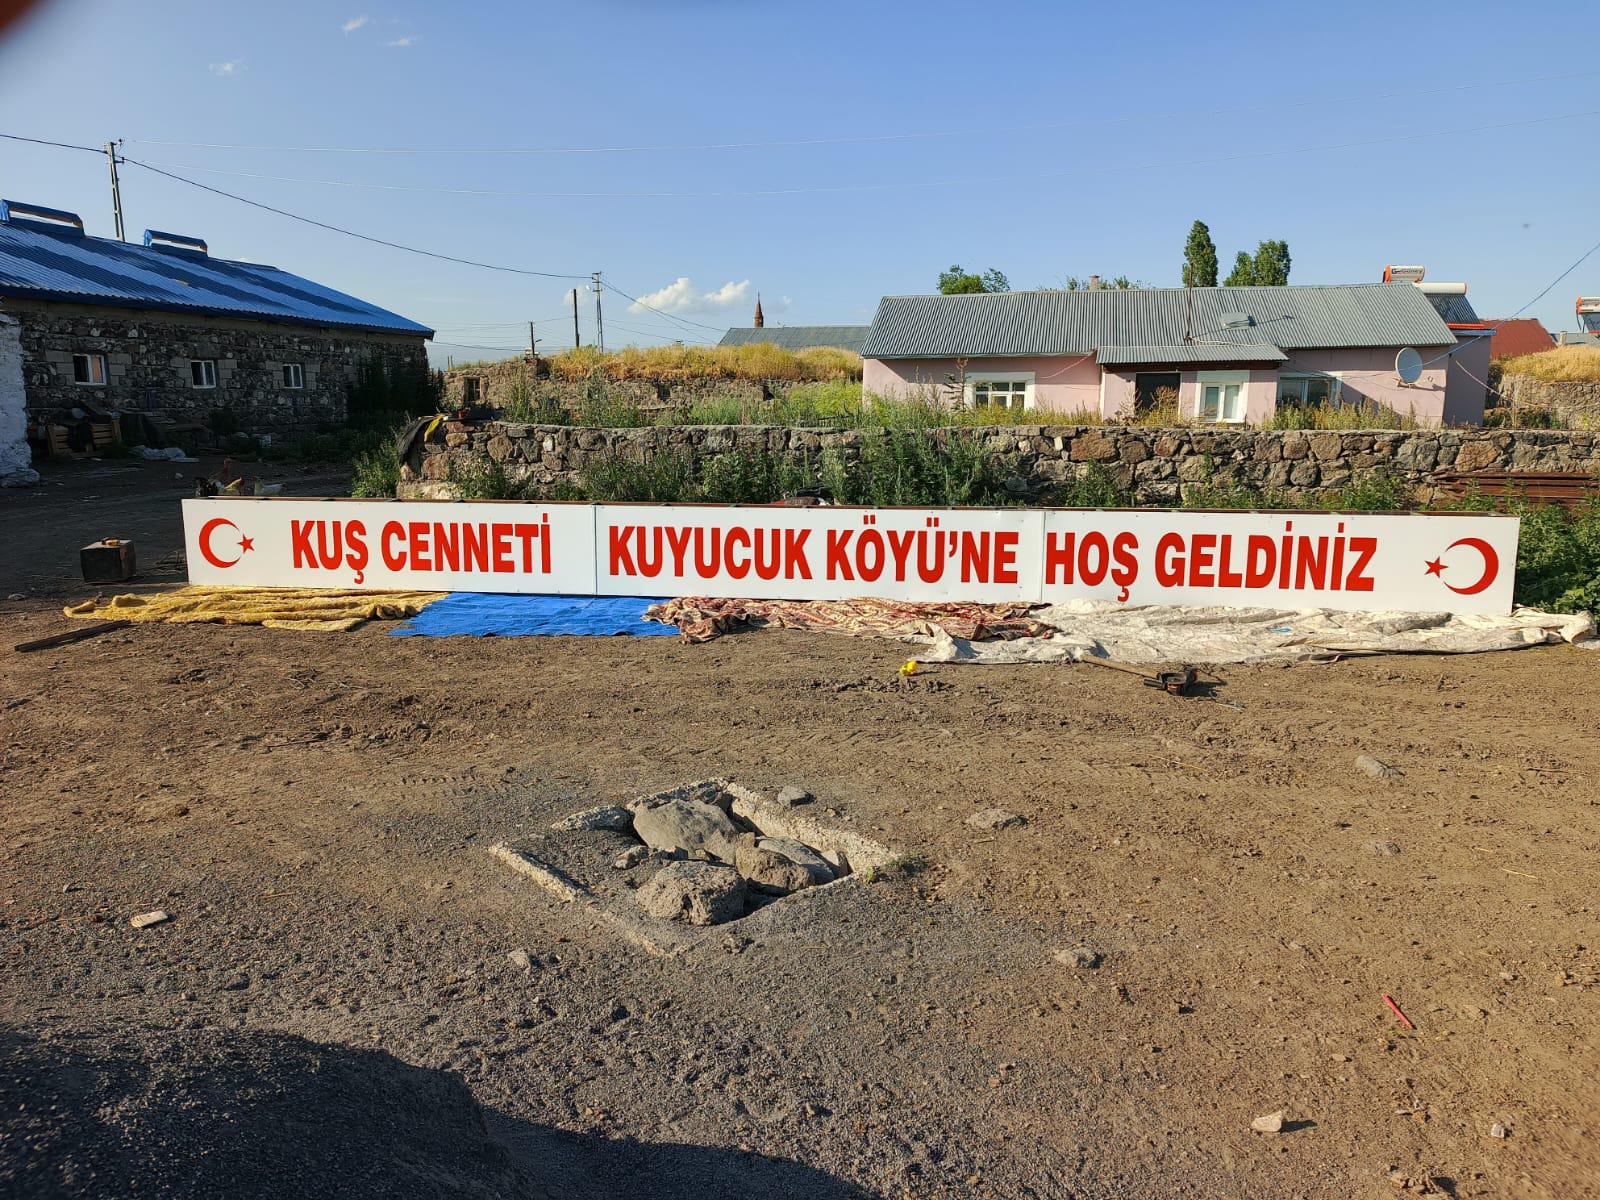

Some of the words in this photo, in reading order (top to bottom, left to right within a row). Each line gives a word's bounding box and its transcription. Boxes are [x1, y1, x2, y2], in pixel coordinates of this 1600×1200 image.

[292, 519, 368, 584] KUŞ
[382, 513, 551, 575] CENNETİ
[609, 525, 813, 580] KUYUCUK
[1046, 532, 1139, 603] HOŞ
[1156, 520, 1377, 592] GELDİNİZ
